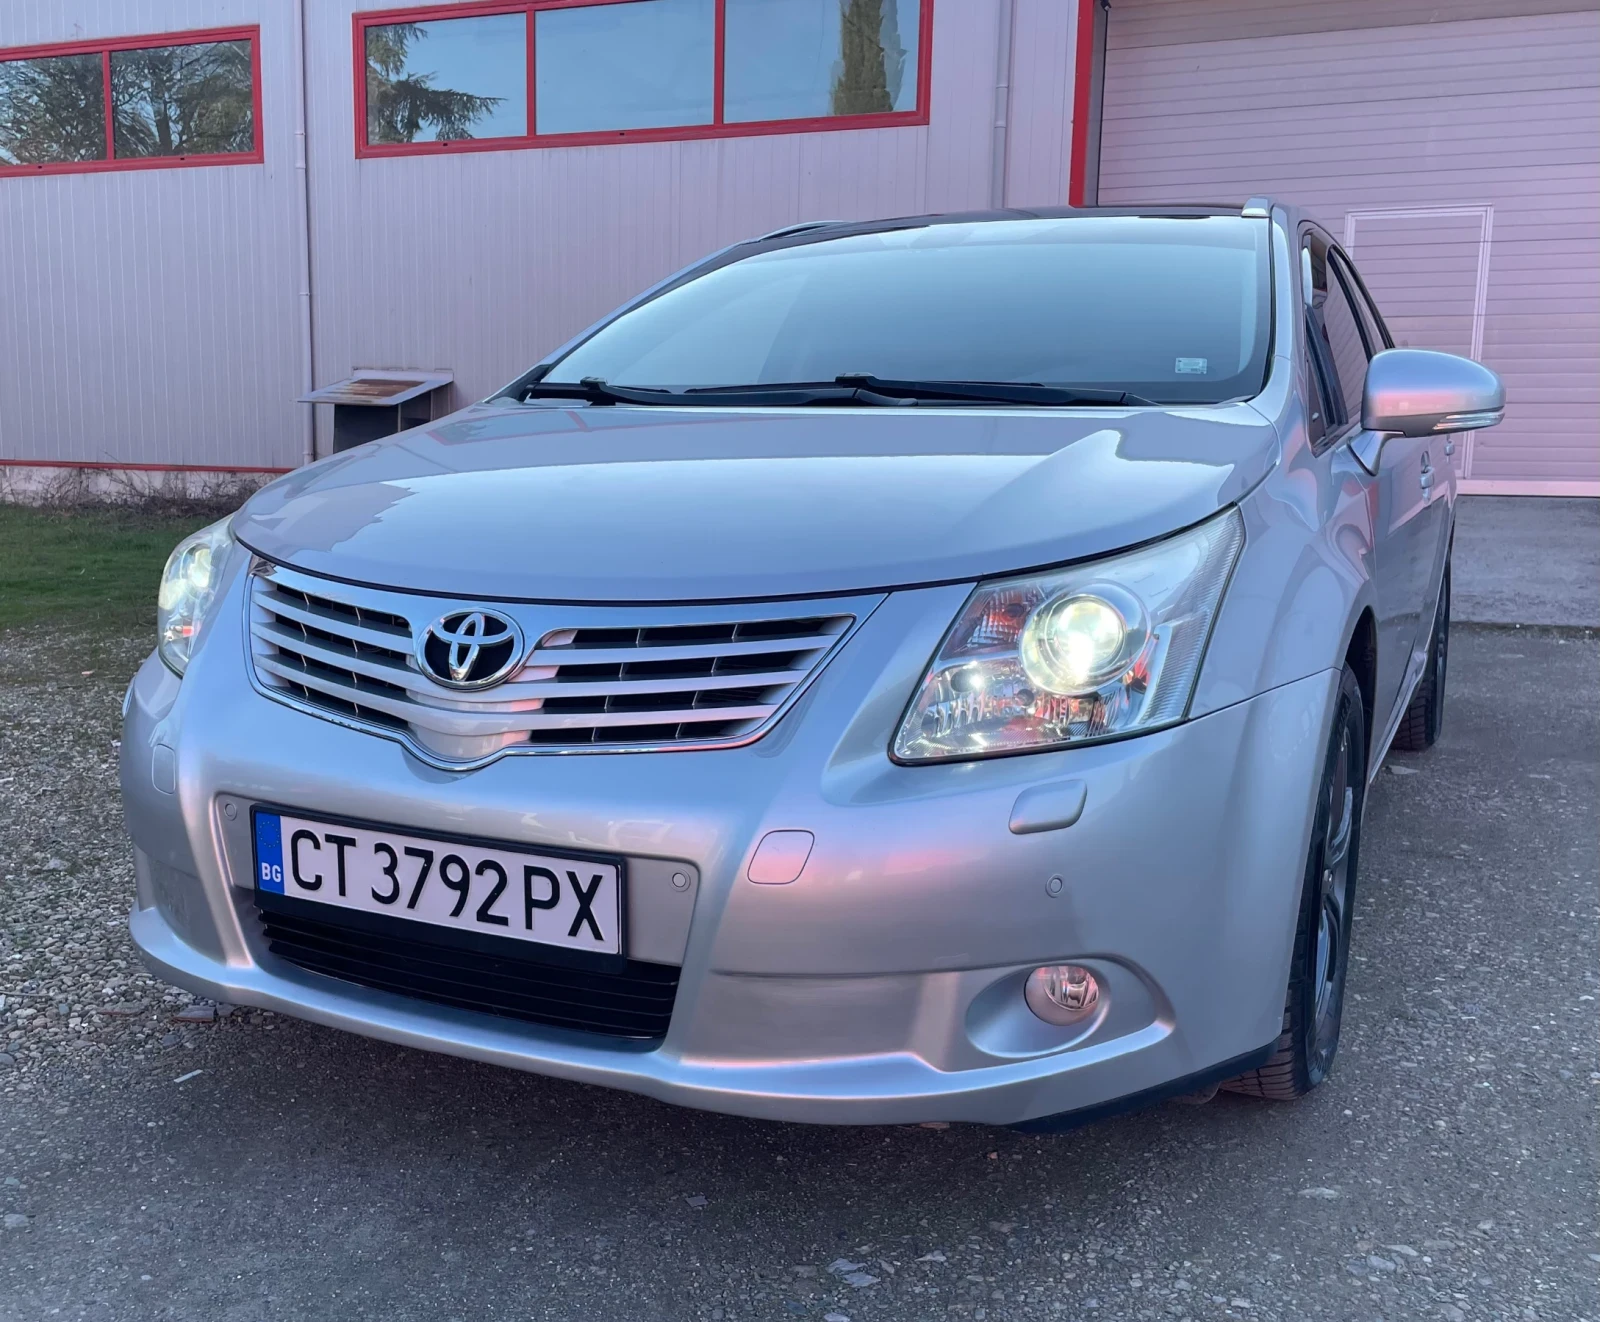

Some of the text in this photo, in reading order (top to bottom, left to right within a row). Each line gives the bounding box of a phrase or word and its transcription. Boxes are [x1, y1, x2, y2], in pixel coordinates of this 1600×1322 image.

[261, 862, 282, 882] BG
[290, 829, 604, 941] CT 3792 PX
